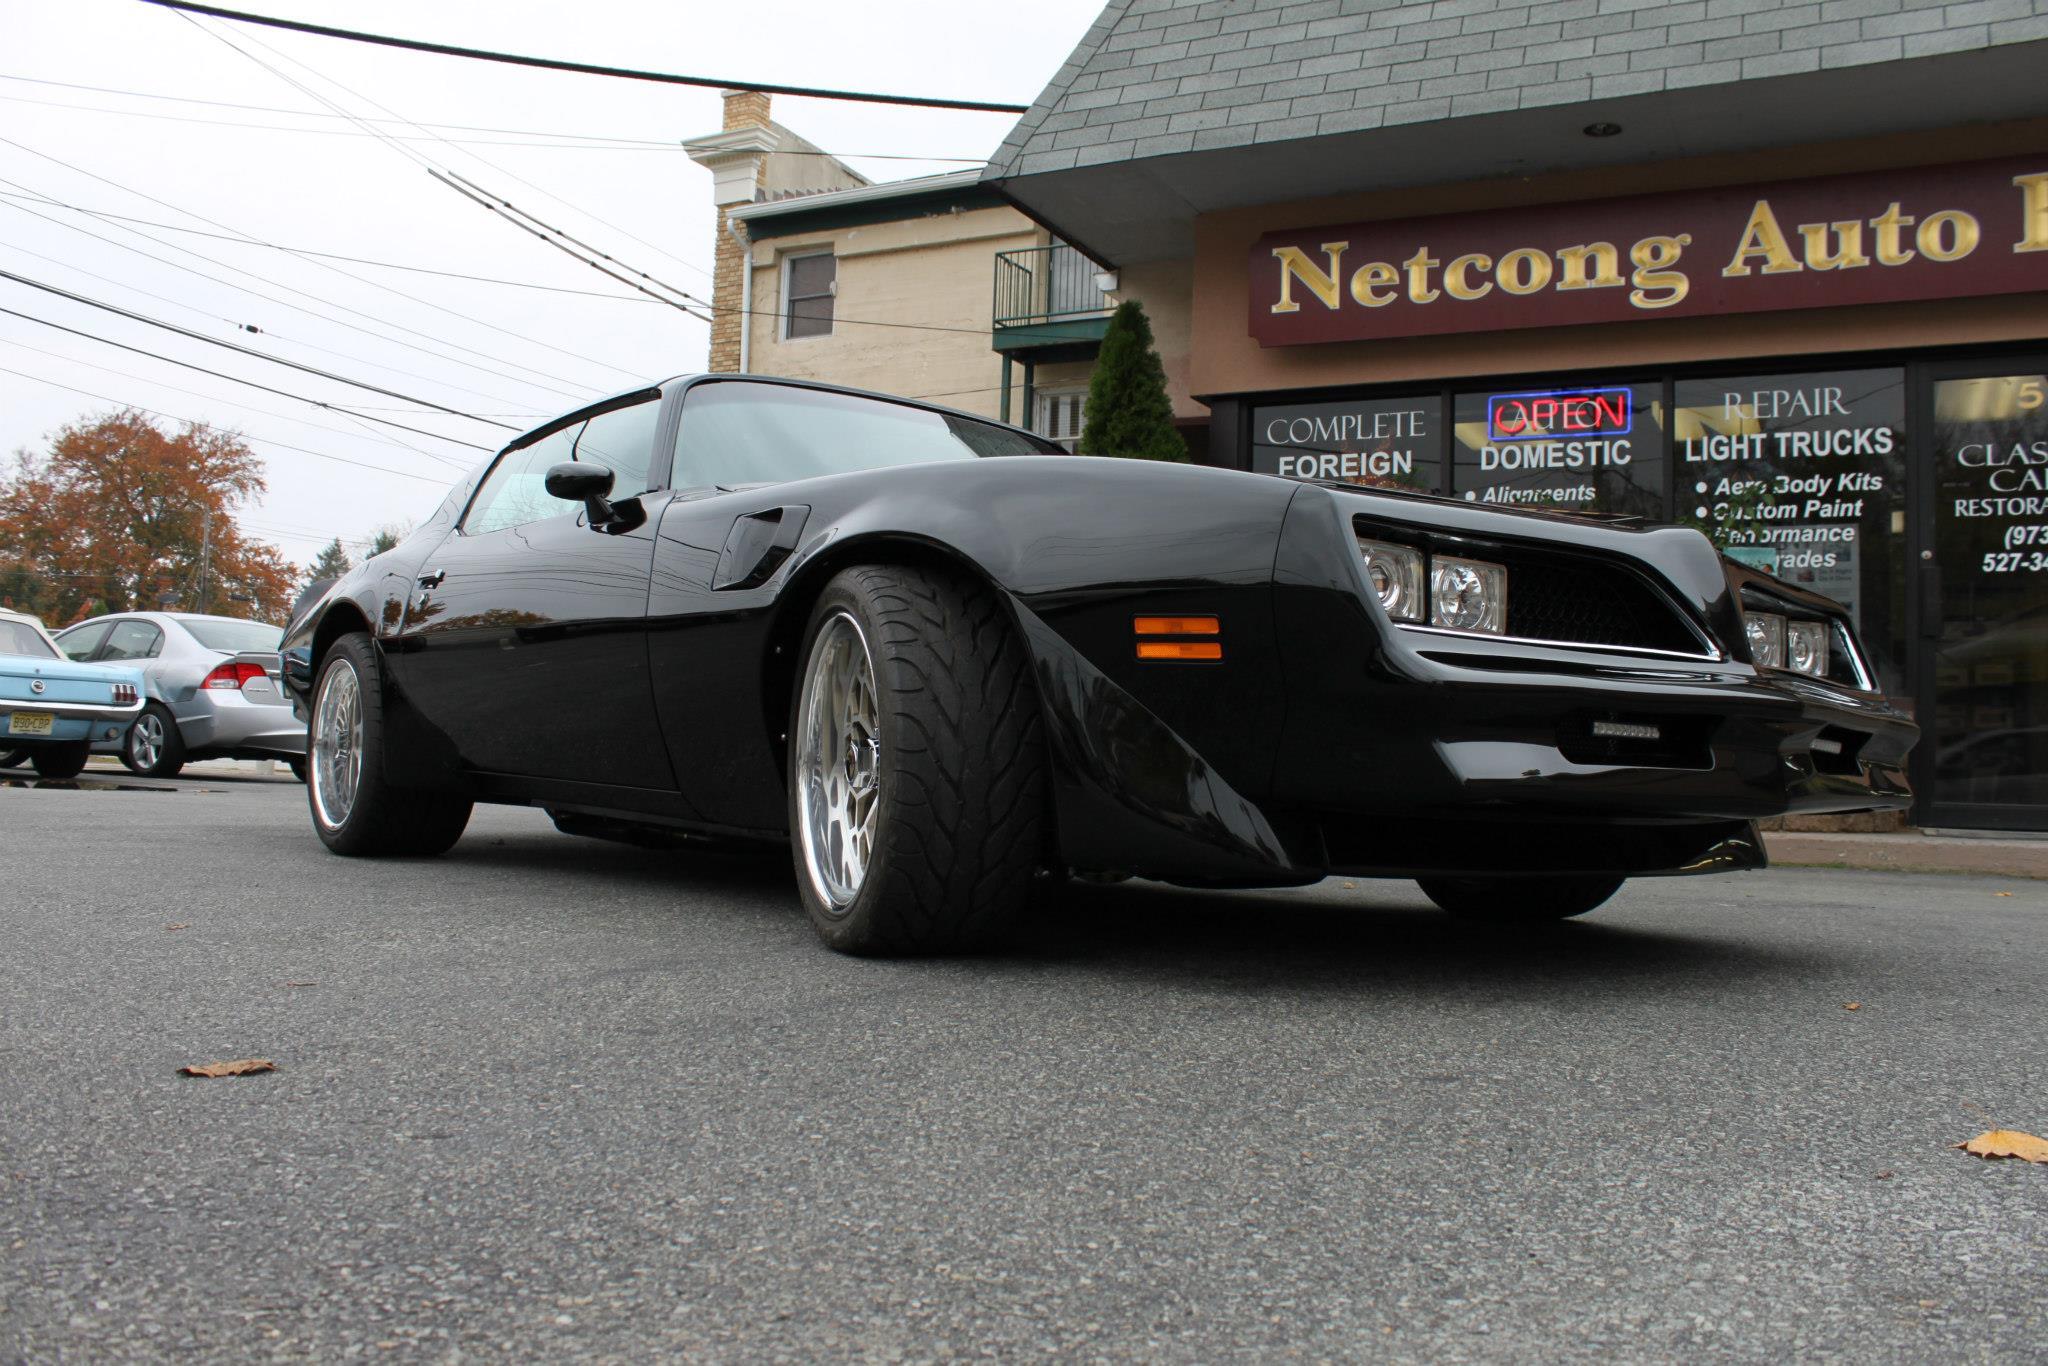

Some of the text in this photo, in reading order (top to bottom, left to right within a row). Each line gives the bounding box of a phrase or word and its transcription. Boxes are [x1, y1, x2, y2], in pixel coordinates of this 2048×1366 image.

[1270, 234, 1693, 312] Netcong
[1722, 199, 1982, 278] Auto
[1494, 395, 1625, 434] OPEN
[1510, 400, 1603, 431] AUTO
[1723, 387, 1852, 421] REPAIR
[1267, 411, 1427, 445] COMPLETE
[1481, 439, 1632, 471] DOMESTIC
[1686, 427, 1894, 463] LIGHT TRUCKS
[1279, 451, 1412, 478] FOREIGN
[1989, 468, 2048, 492] CA
[1774, 474, 1833, 497] Body
[1837, 472, 1884, 493] Kits
[1714, 499, 1863, 521] Cutom Paint
